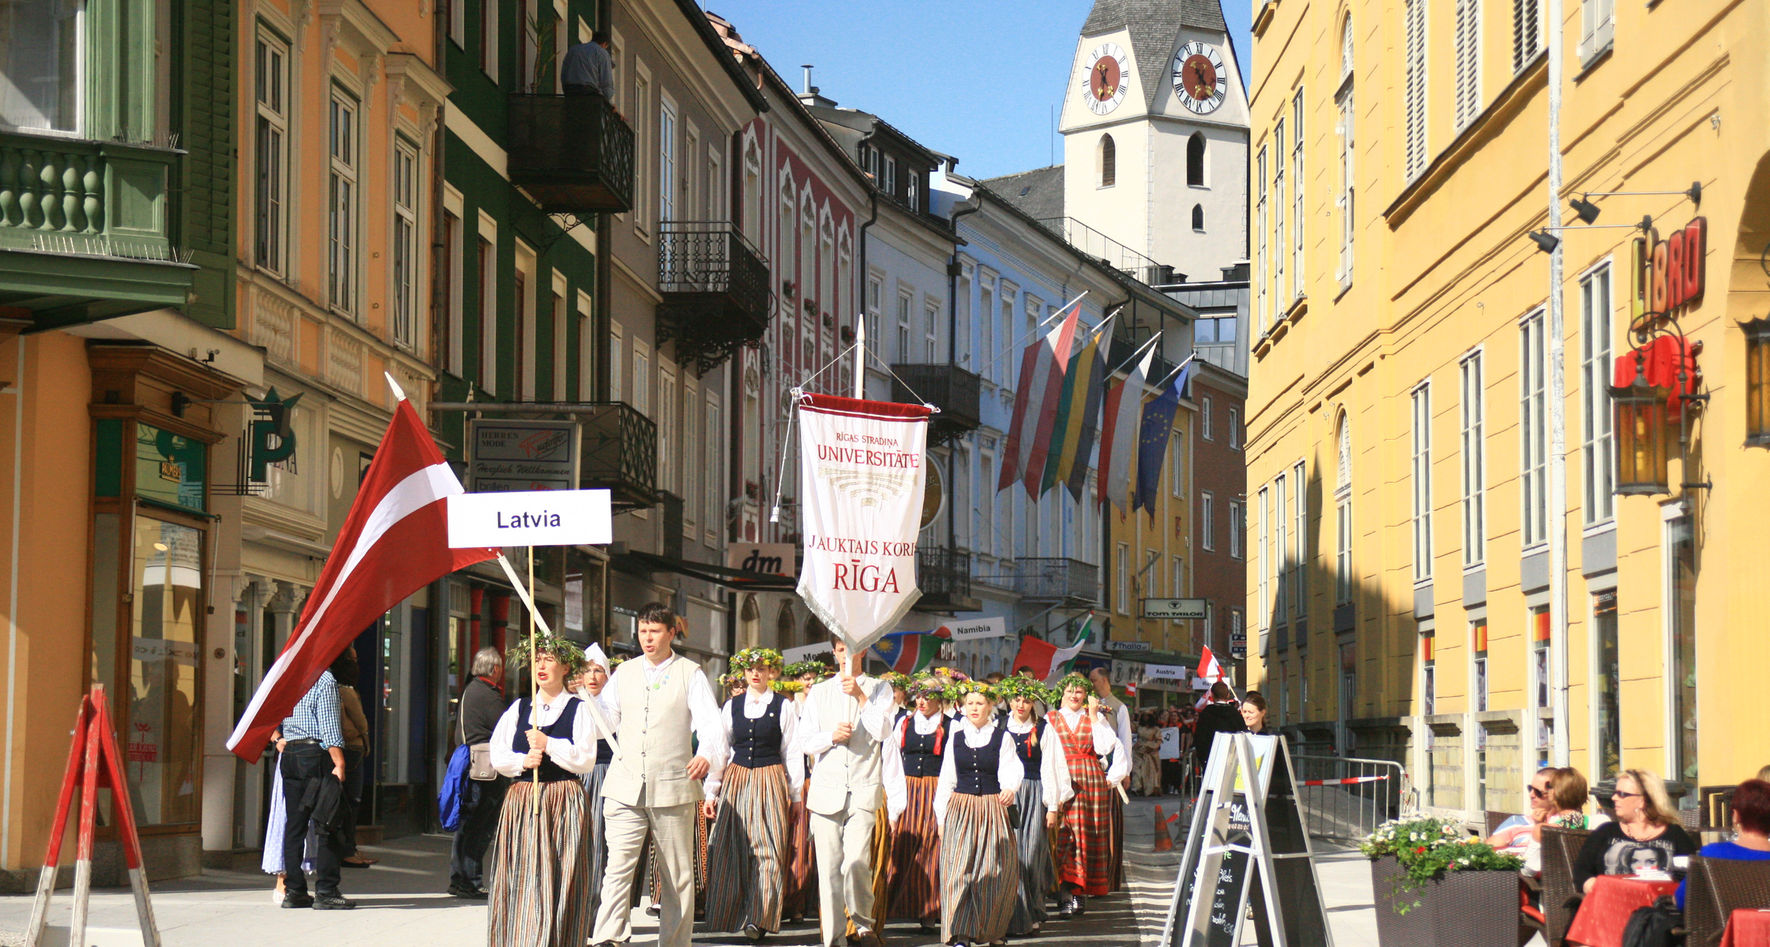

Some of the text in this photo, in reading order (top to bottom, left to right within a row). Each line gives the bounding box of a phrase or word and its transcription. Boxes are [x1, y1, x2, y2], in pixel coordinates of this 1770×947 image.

[481, 431, 519, 439] HERREN
[836, 432, 859, 443] RĪGAS
[817, 444, 920, 468] UNIVERSITĀTE
[497, 510, 561, 529] Latvia
[808, 535, 916, 557] JAUKTAIS KORI
[742, 549, 782, 573] dm
[832, 559, 900, 593] RĪGA
[957, 625, 991, 635] Namibia
[1155, 668, 1176, 676] Austria
